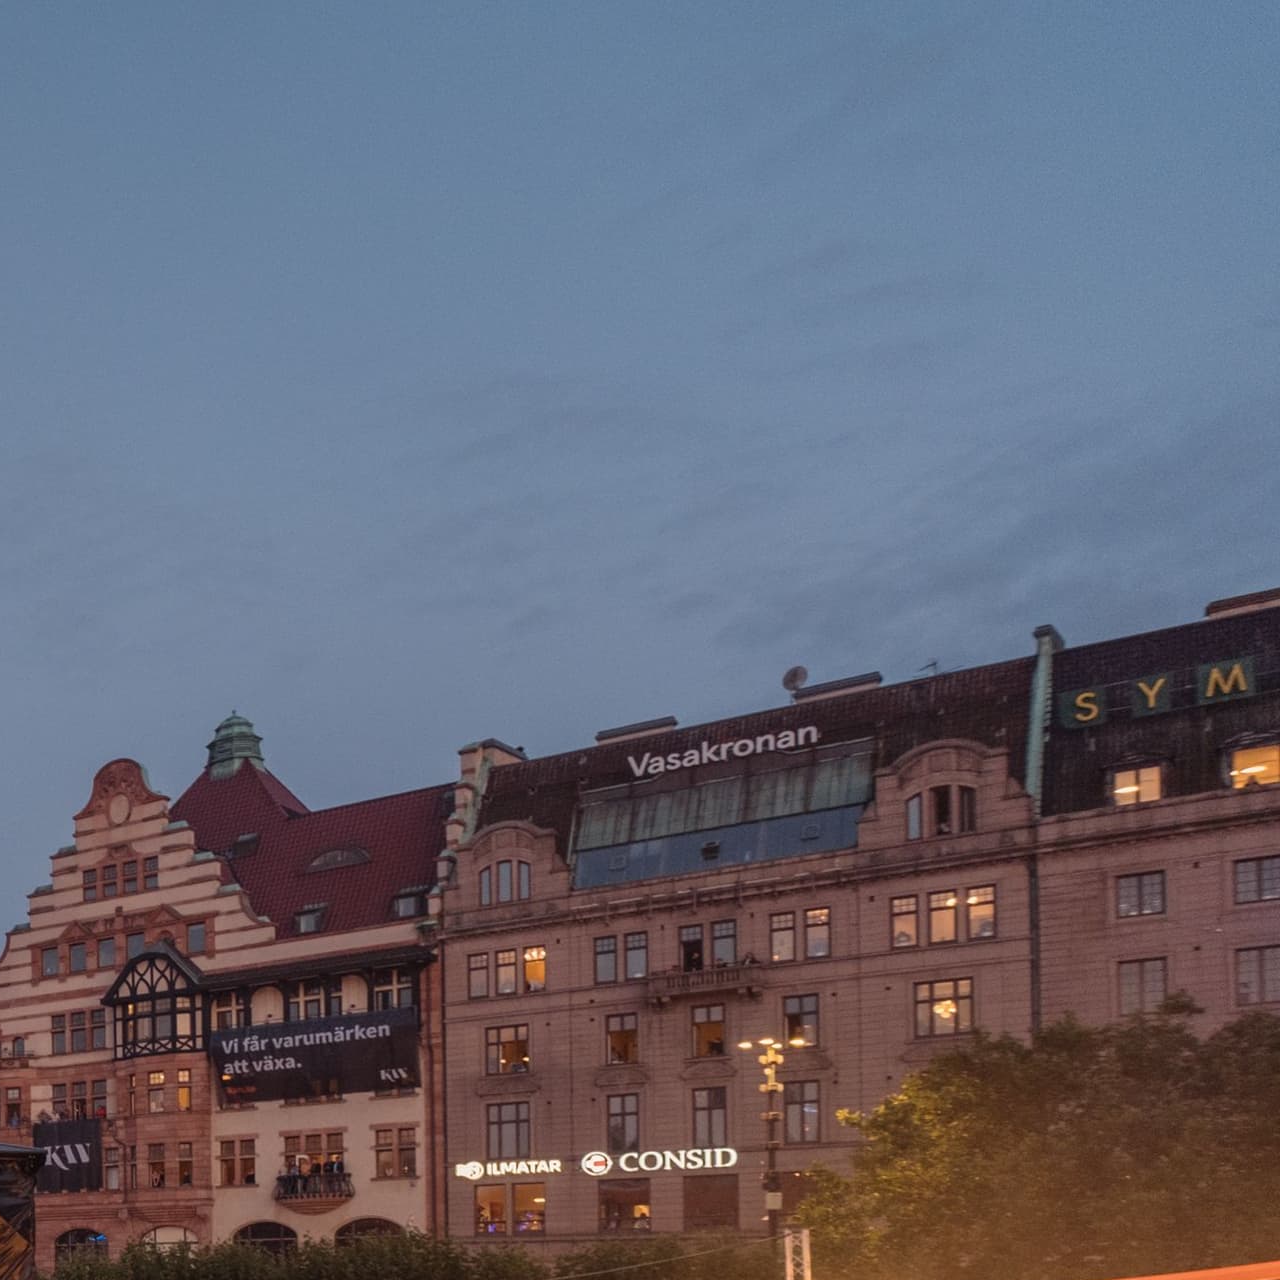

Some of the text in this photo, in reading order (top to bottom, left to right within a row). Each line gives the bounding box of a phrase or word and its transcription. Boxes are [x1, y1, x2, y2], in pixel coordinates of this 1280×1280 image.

[627, 725, 819, 777] Vasakronan
[221, 1024, 391, 1054] Vi får varumärken
[223, 1056, 303, 1074] att växa.
[486, 1159, 562, 1176] ILMATAR
[619, 1148, 738, 1172] CONSID
